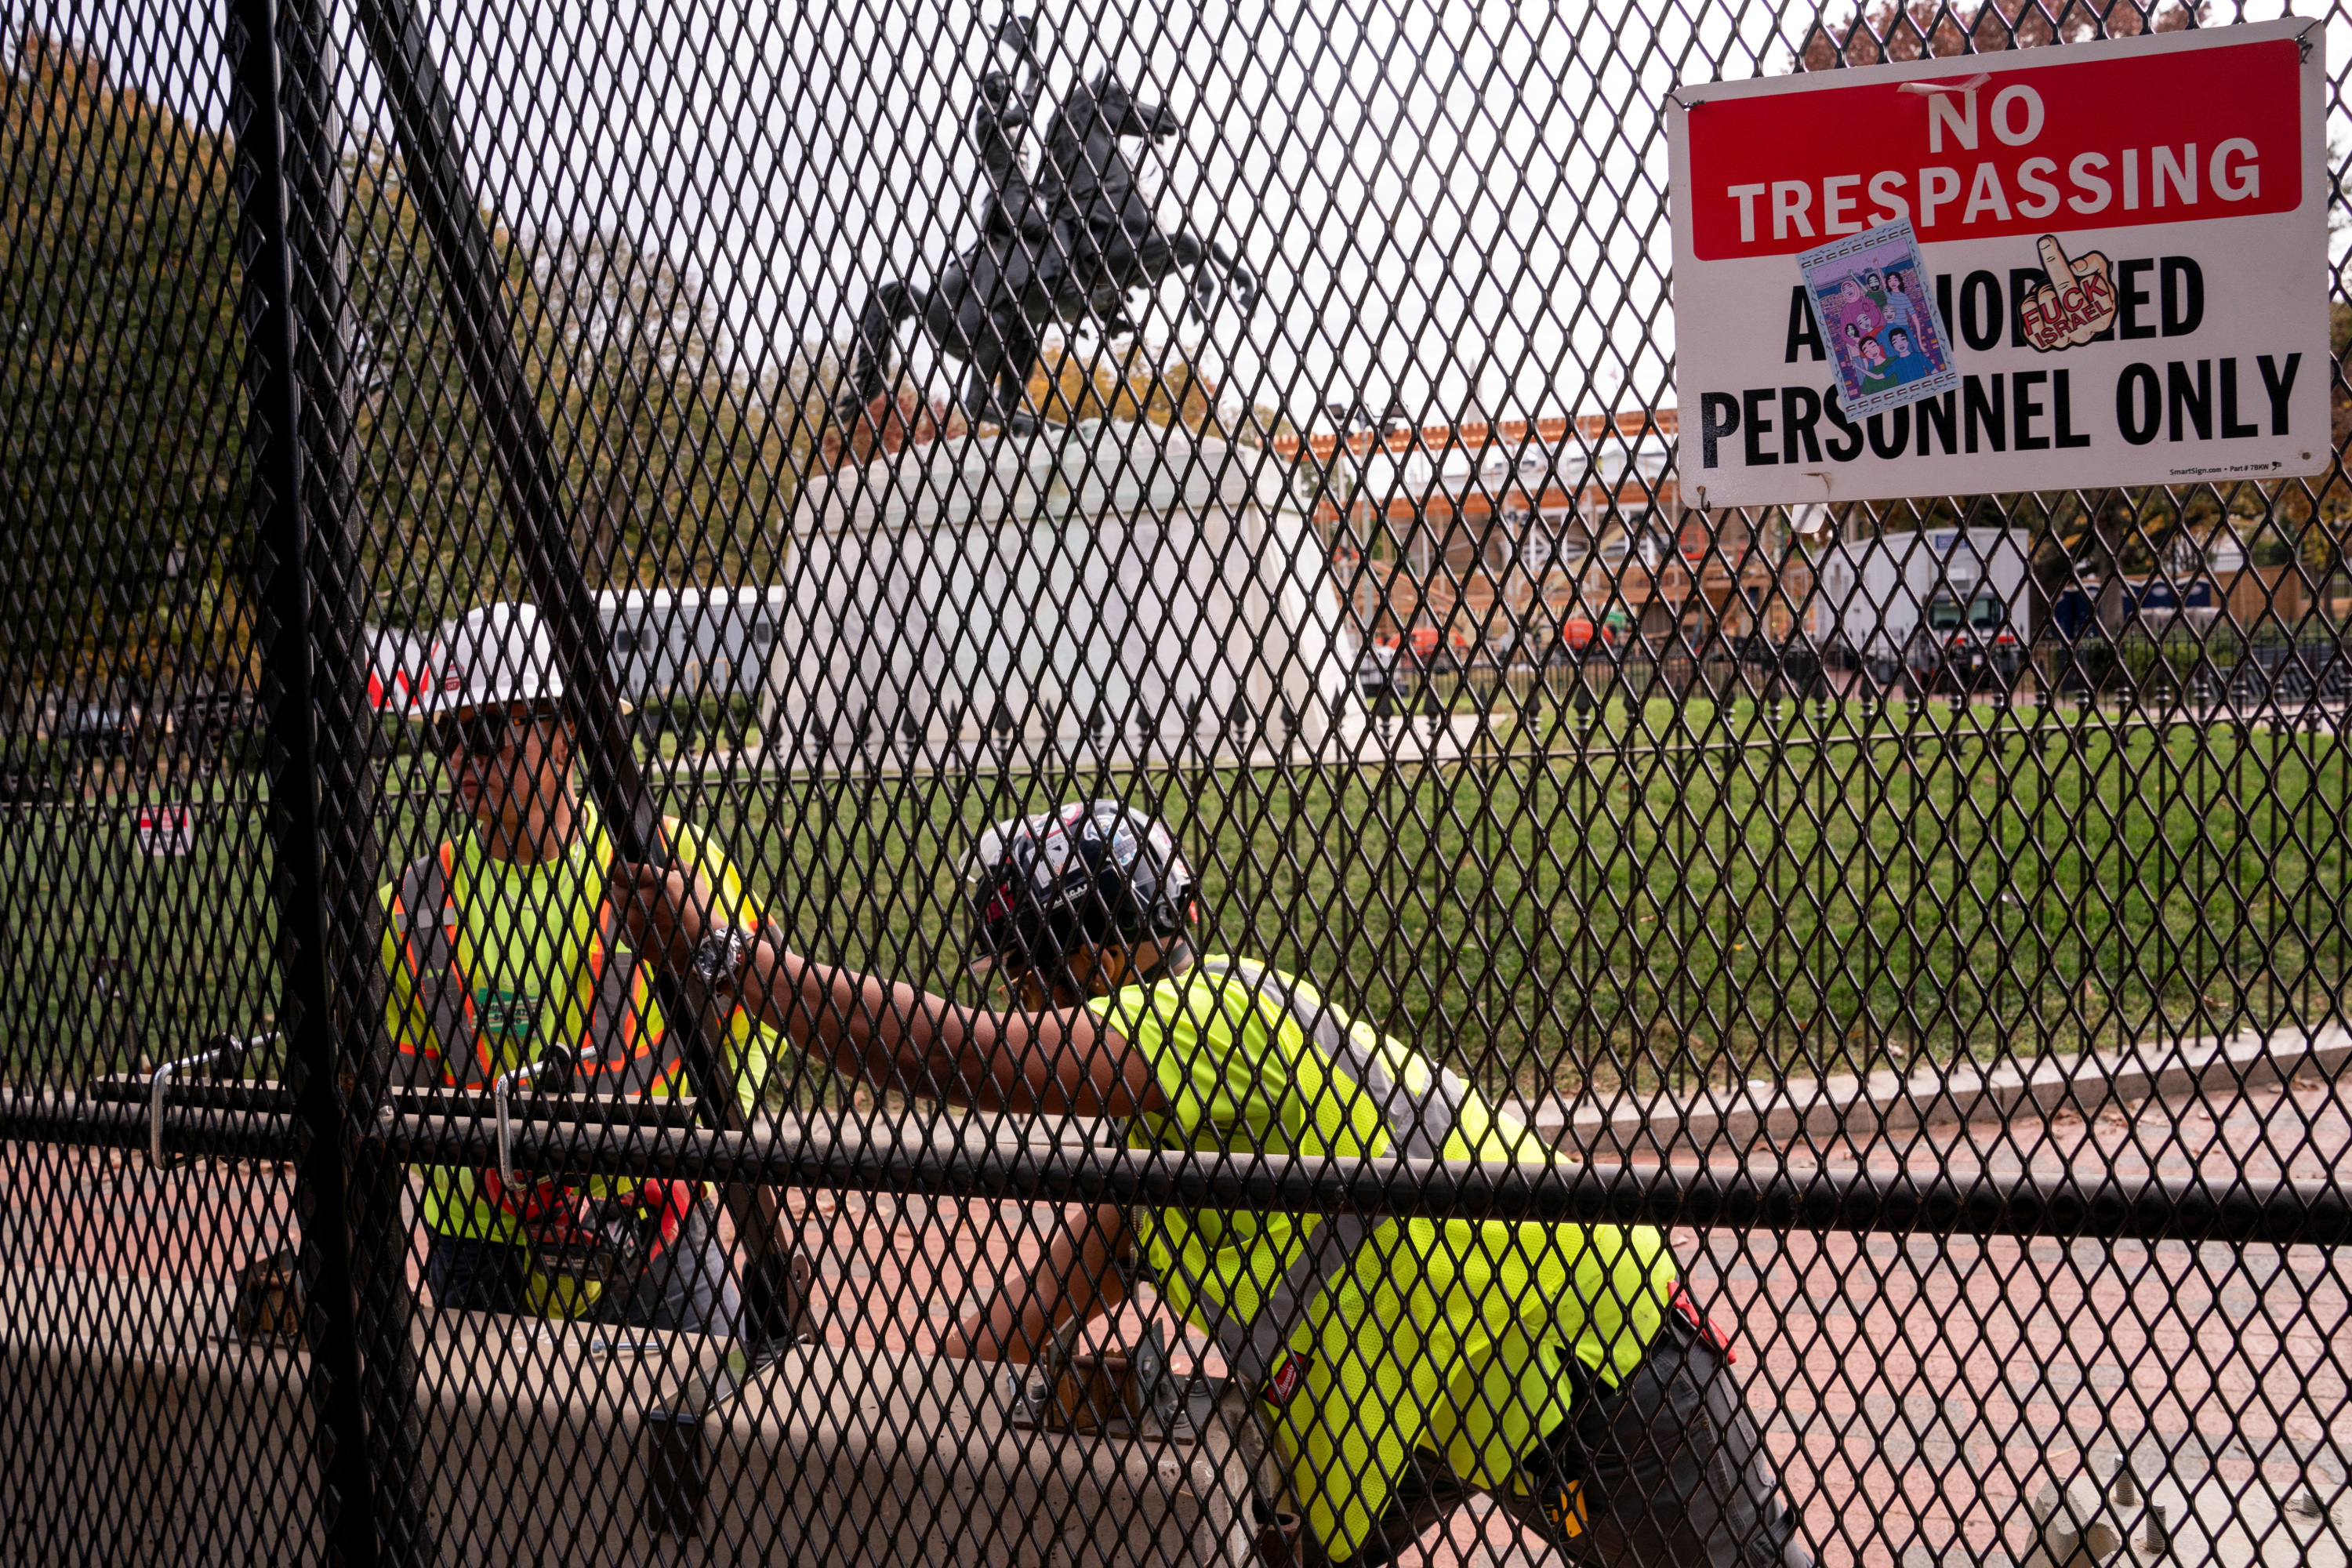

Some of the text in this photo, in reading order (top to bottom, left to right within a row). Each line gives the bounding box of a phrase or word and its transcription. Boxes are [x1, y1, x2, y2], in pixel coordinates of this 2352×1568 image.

[1928, 84, 2045, 154] NO
[1727, 137, 2260, 243] TRESPASSING
[2021, 274, 2109, 336] FUCK
[2035, 300, 2113, 347] ISRAEL
[2115, 352, 2303, 446] ONLY
[2169, 467, 2222, 476] SmartSign.com
